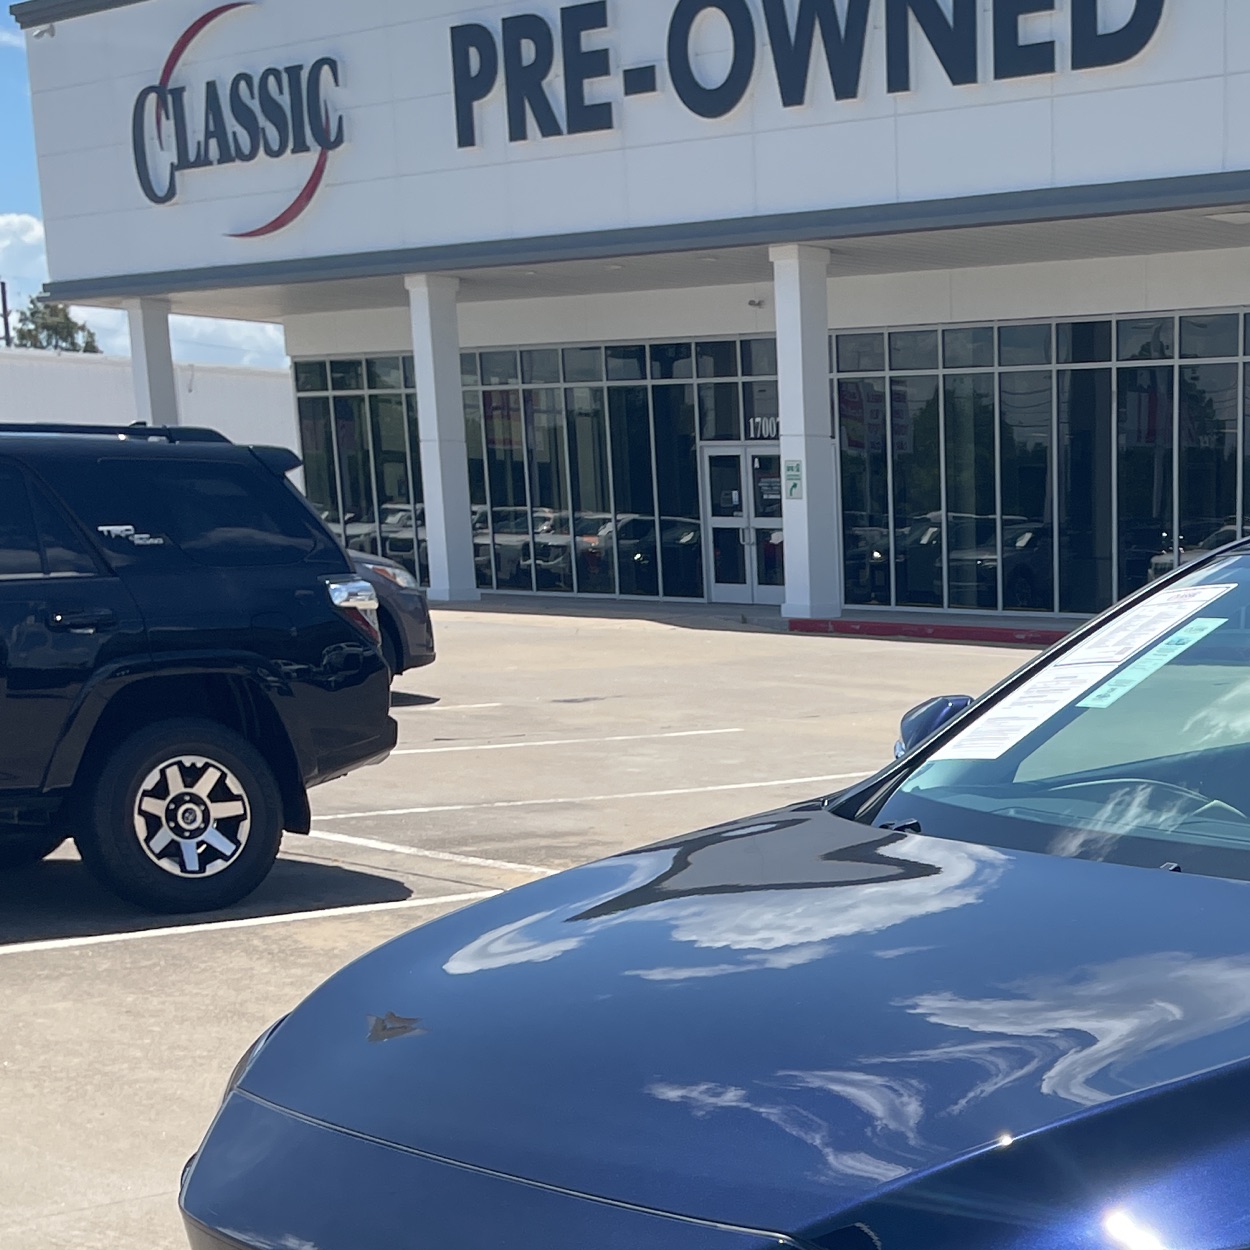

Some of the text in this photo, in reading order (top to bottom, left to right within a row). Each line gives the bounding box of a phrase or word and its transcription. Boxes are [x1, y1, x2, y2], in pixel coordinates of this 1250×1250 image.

[132, 57, 345, 205] CLASSIC
[450, 0, 1166, 148] PRE-OWNED
[748, 416, 780, 438] 1700
